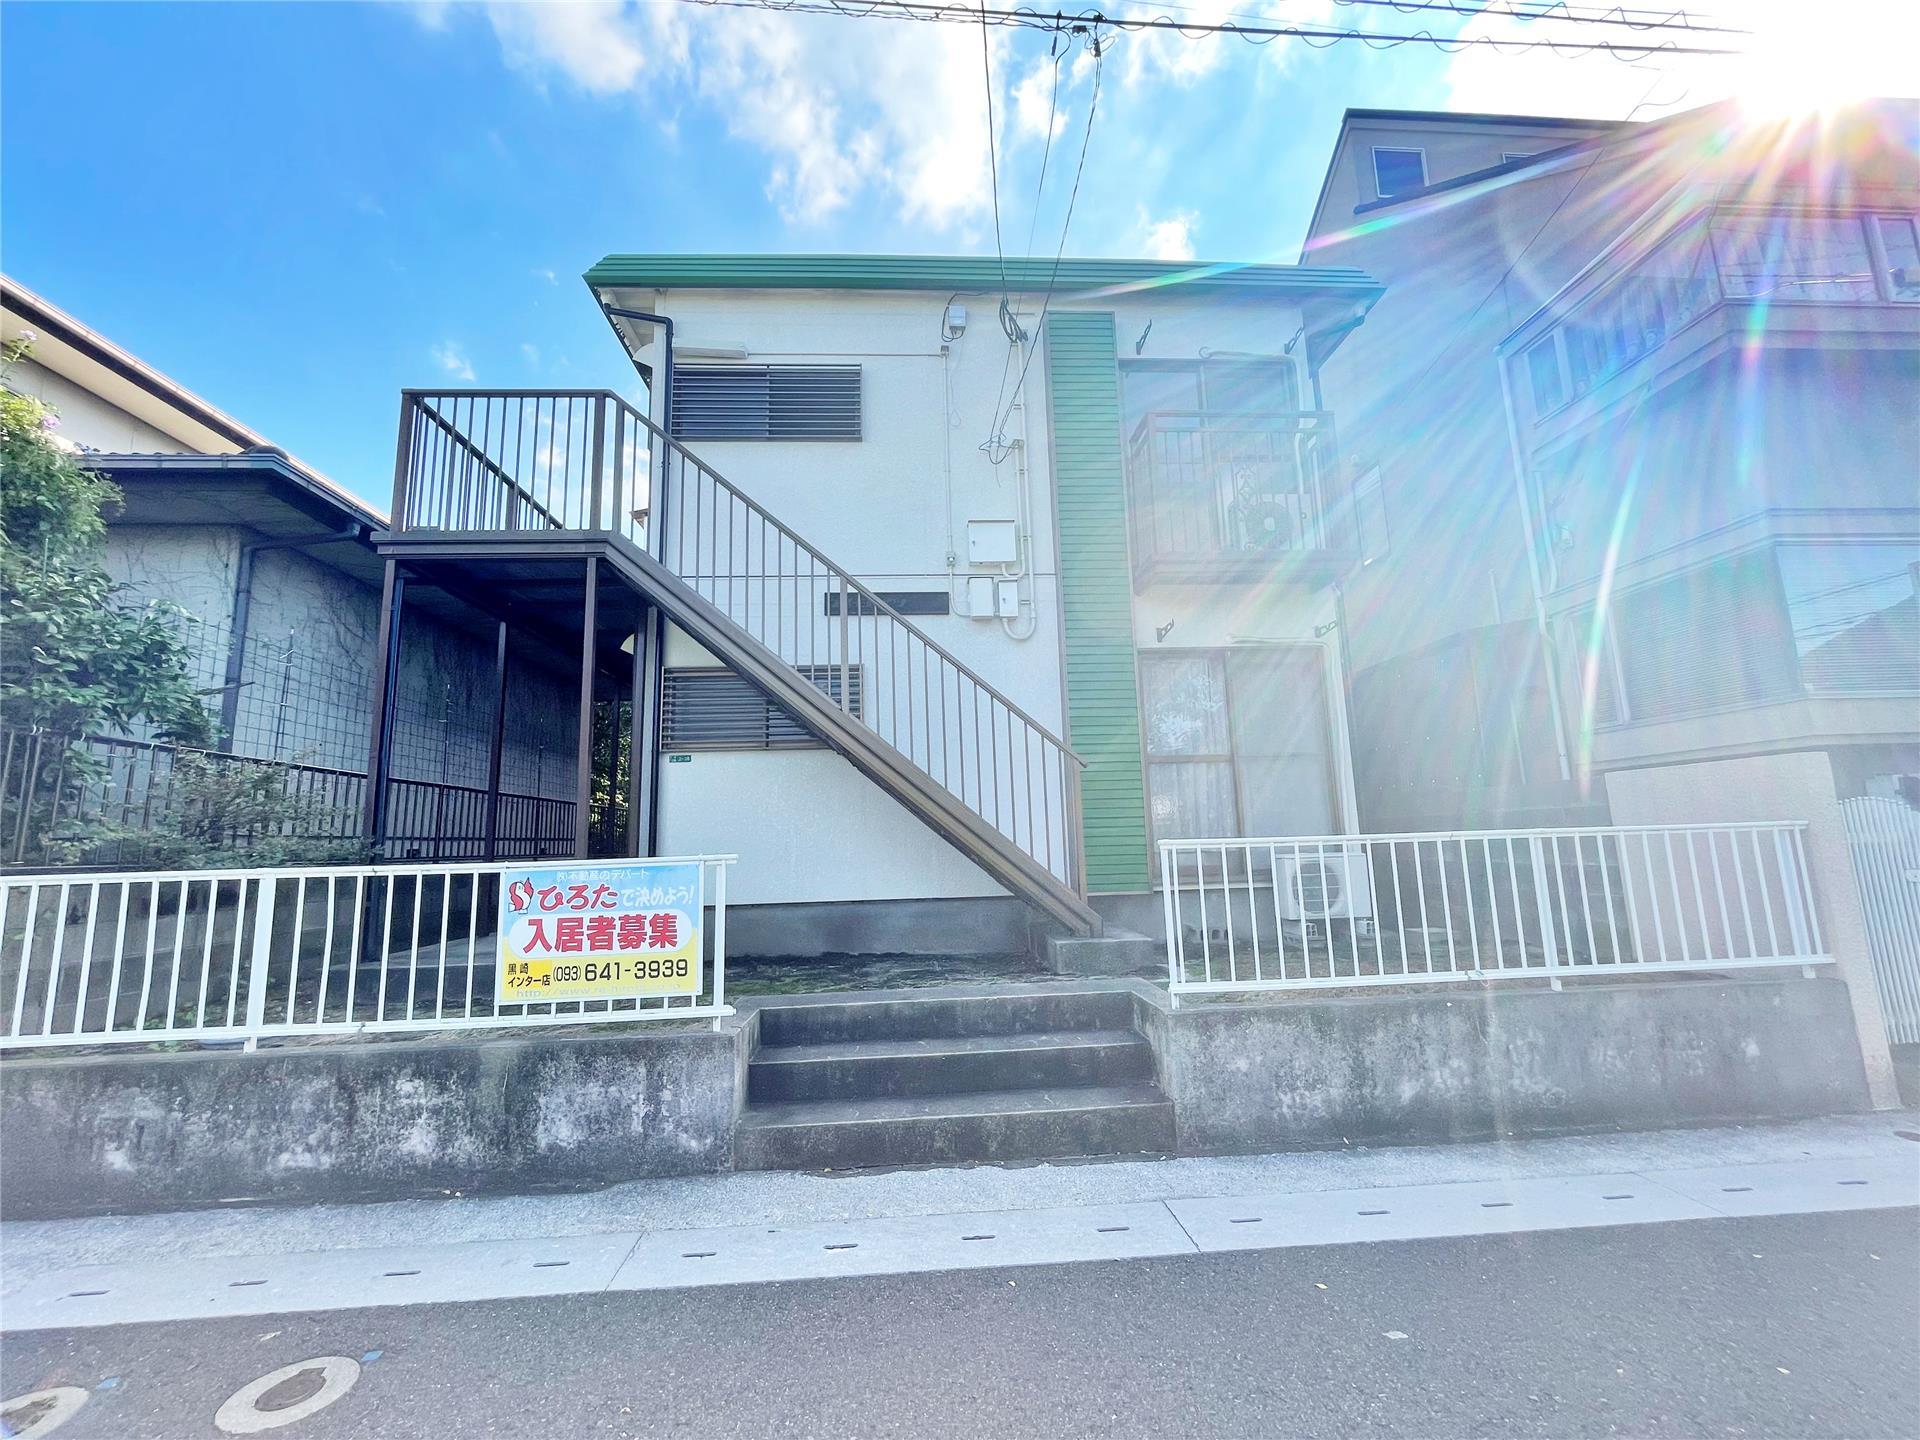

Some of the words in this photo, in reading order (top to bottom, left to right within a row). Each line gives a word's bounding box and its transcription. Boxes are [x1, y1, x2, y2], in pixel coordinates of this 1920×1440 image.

[523, 913, 677, 954] 入居者募集
[507, 975, 551, 988] インター店
